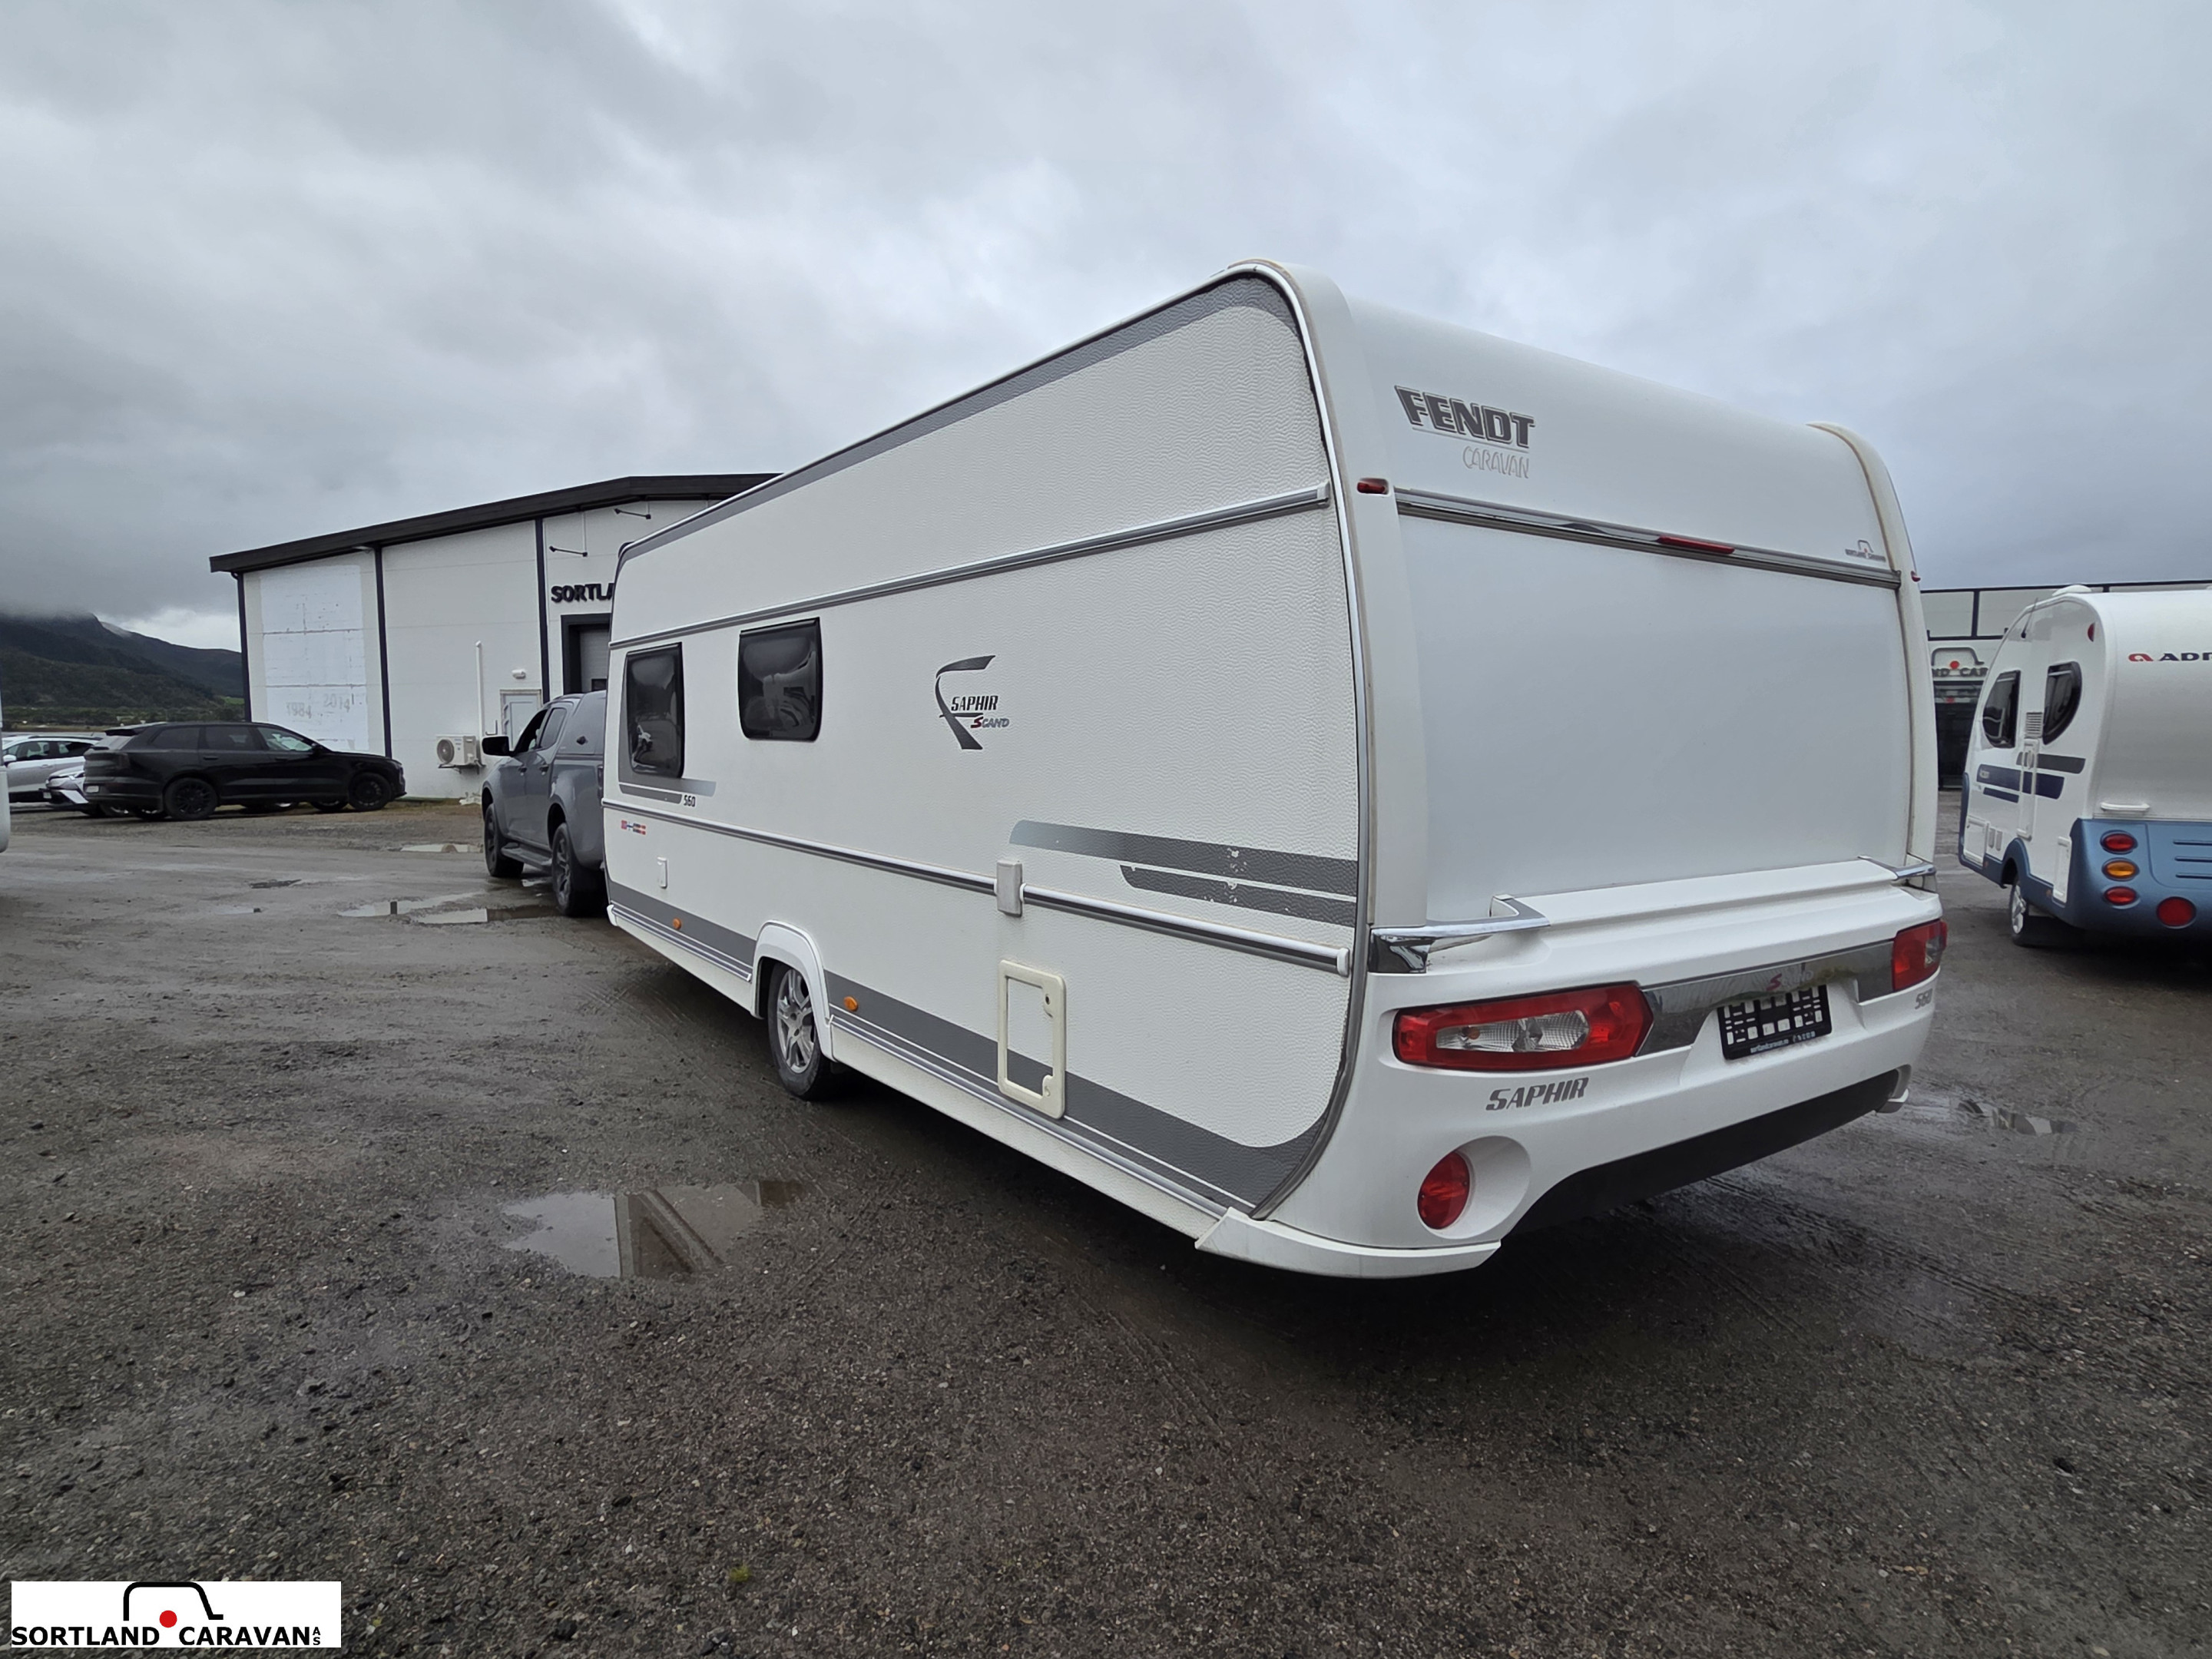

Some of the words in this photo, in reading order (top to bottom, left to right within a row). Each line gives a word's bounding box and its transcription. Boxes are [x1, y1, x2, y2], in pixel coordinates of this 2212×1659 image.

[1394, 386, 1535, 449] FENDT
[1462, 445, 1529, 478] CARAVAN
[951, 695, 998, 711] SAPHIR
[970, 716, 1010, 728] SCAND
[684, 794, 696, 807] 560
[1485, 1077, 1589, 1111] SAPHIR
